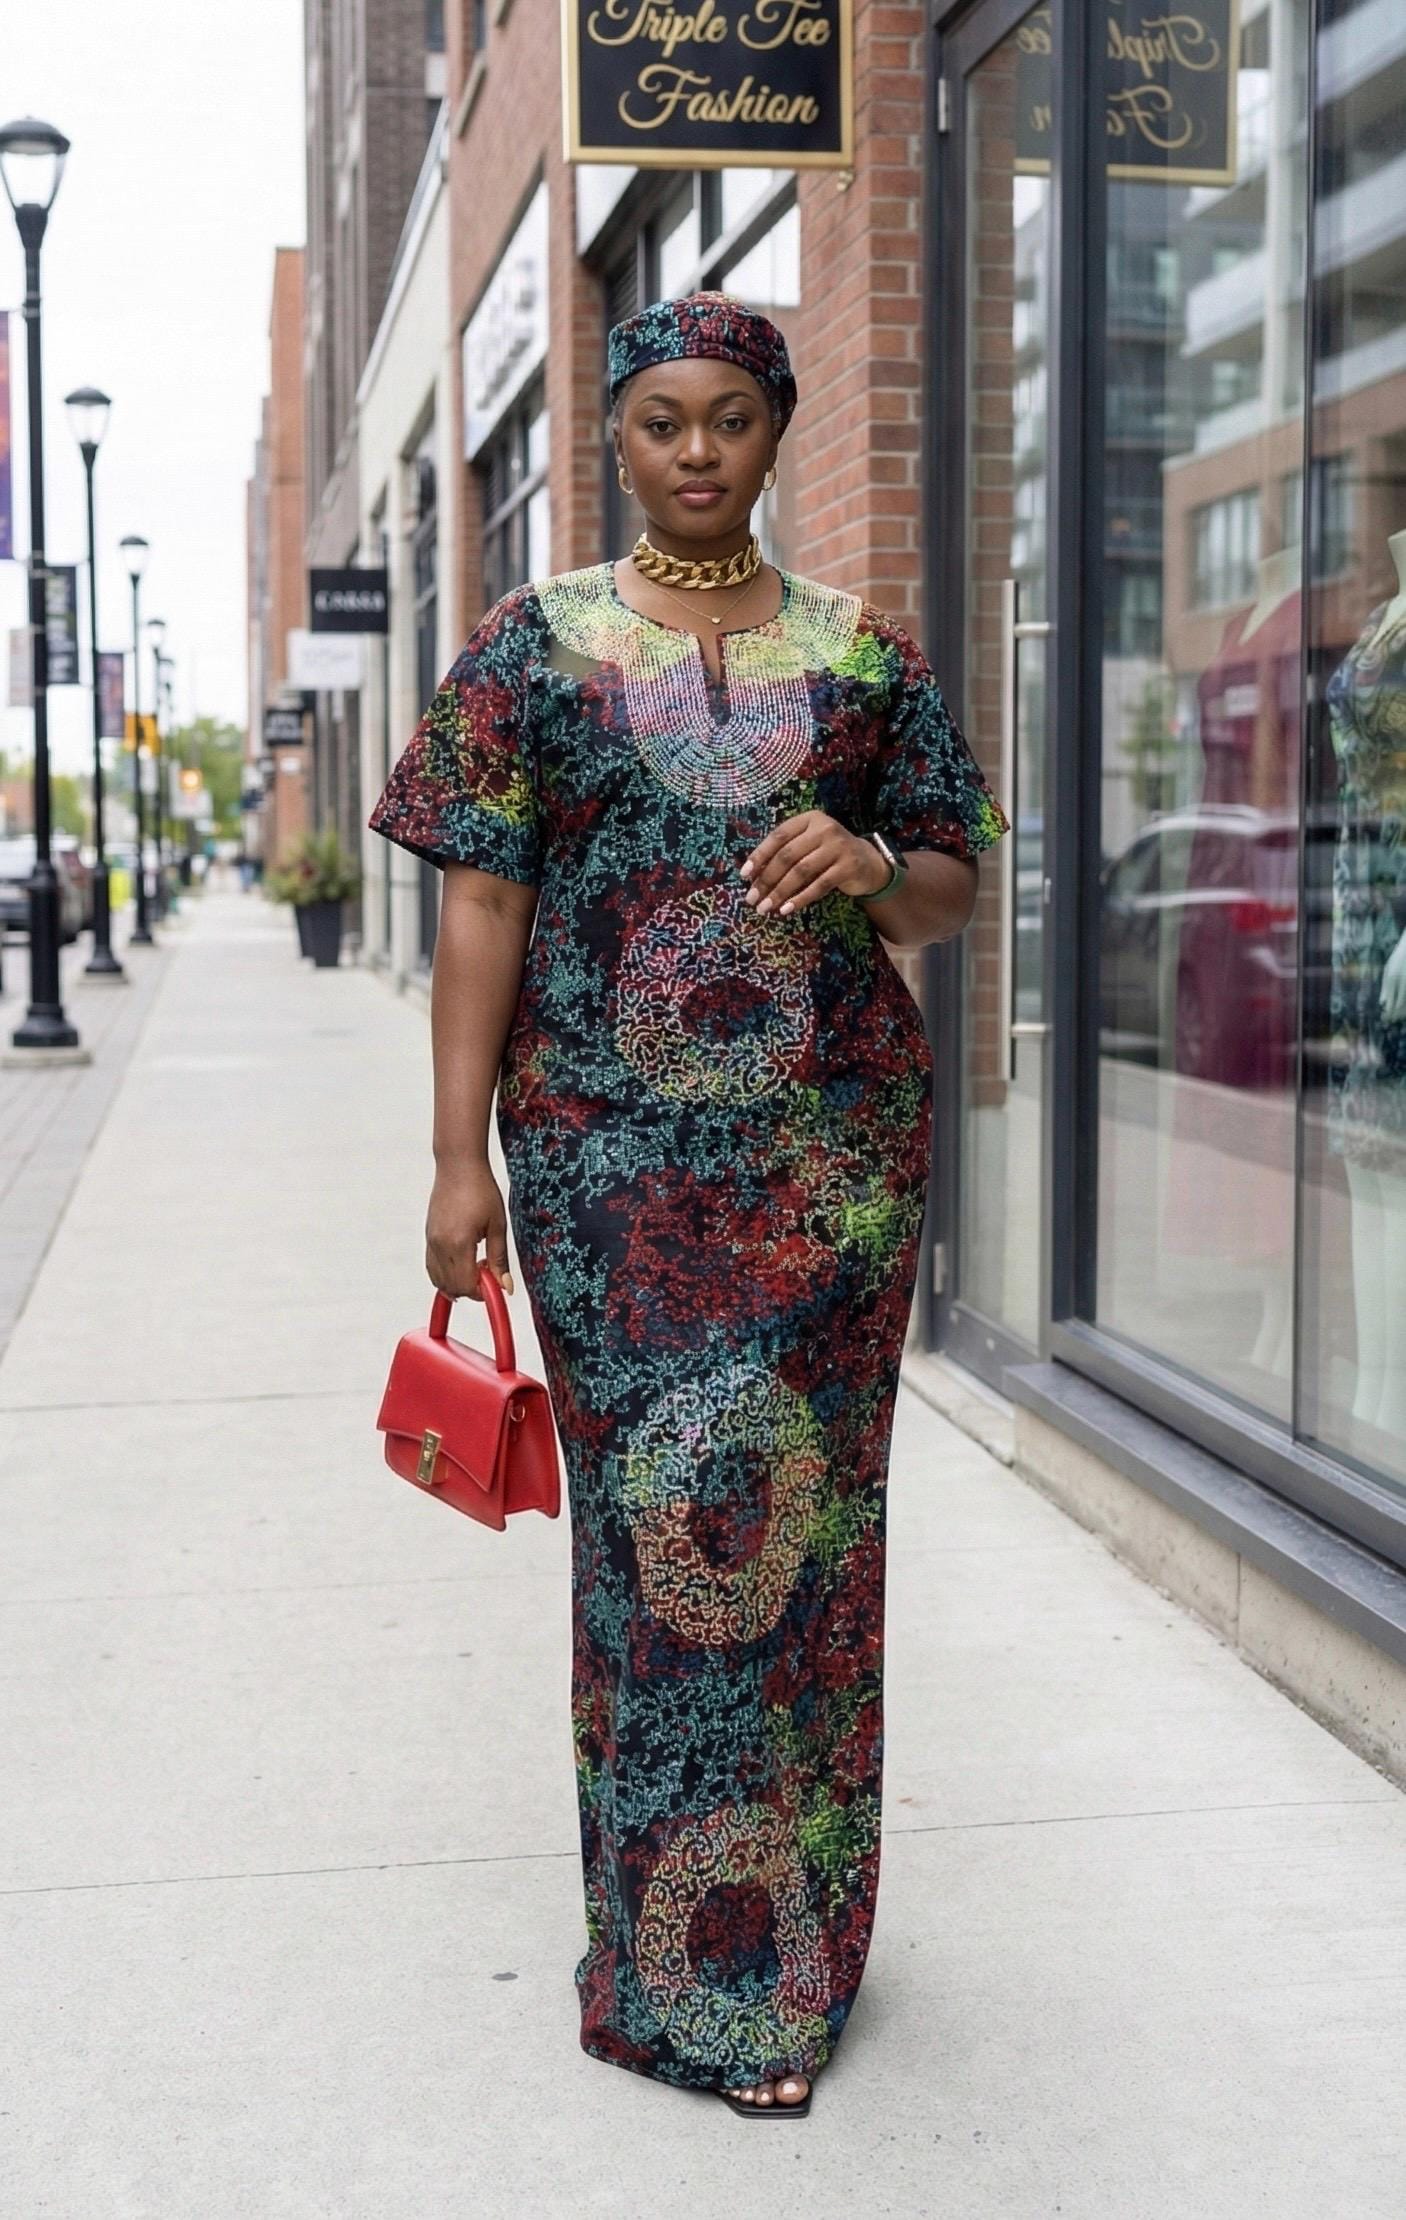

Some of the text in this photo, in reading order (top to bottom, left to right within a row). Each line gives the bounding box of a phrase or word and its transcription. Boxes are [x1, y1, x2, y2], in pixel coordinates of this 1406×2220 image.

[588, 0, 831, 57] Triple Tee
[618, 64, 820, 129] Fashion
